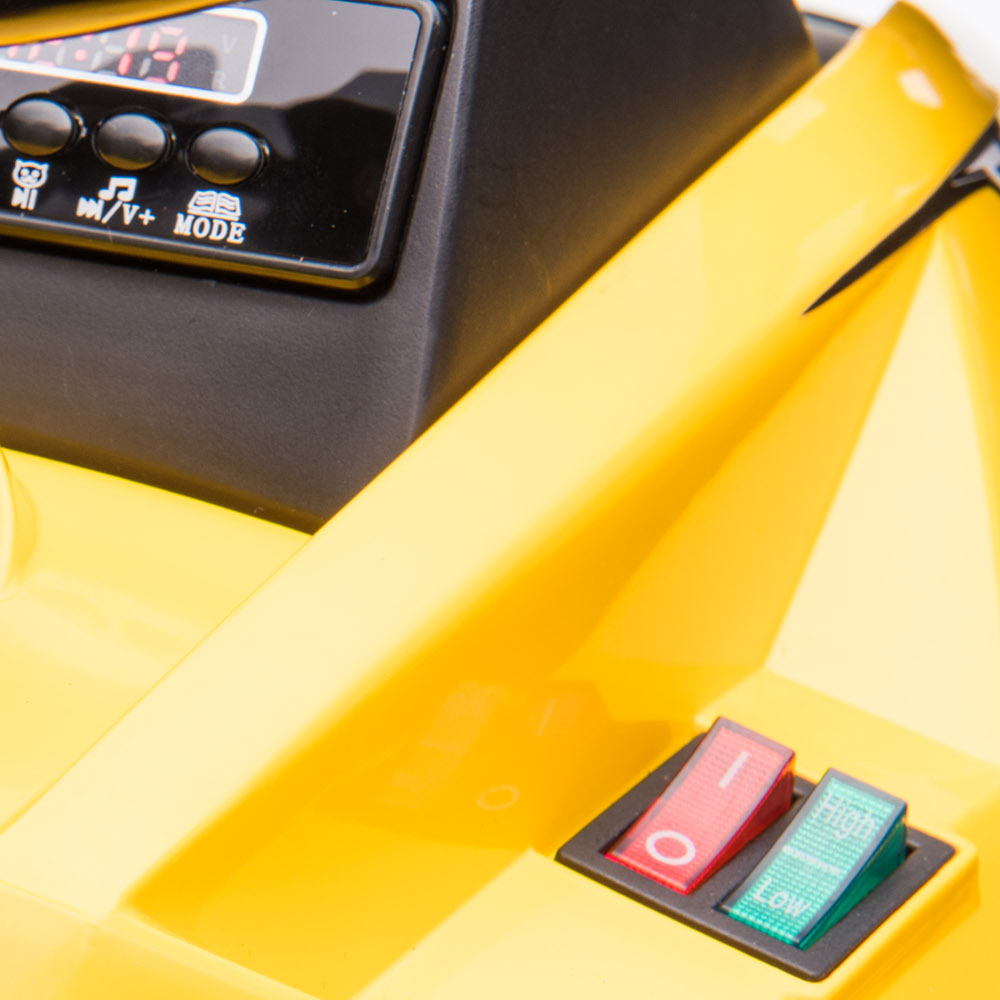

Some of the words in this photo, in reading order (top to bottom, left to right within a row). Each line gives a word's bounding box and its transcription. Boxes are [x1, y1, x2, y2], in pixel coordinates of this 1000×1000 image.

[173, 213, 246, 244] MODE
[812, 792, 876, 841] High
[752, 877, 811, 918] Low
